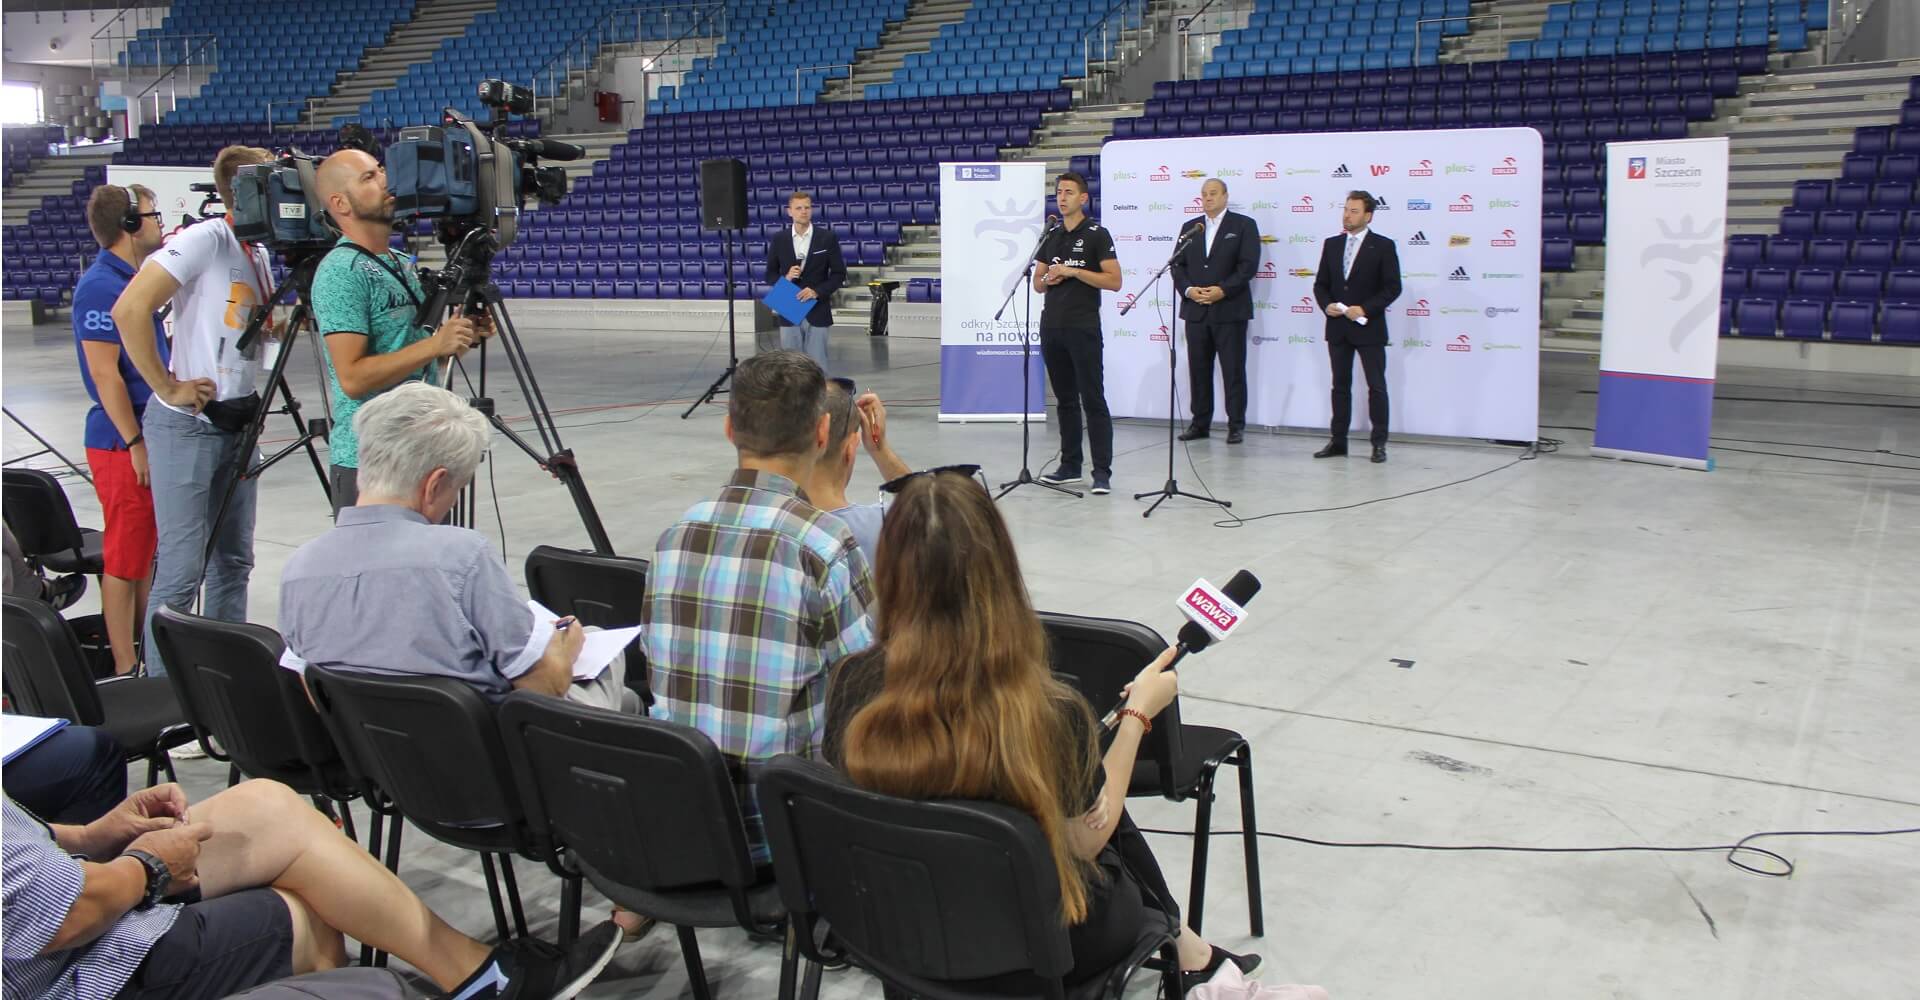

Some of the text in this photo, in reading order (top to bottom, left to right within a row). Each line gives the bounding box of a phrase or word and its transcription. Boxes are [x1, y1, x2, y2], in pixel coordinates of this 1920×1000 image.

[1655, 157, 1686, 165] Miasto
[1370, 165, 1390, 176] WP
[1655, 167, 1702, 178] Szczecin
[84, 310, 113, 331] 85
[961, 320, 1040, 330] odkryj Szczein
[976, 332, 1039, 341] na nowo
[1191, 591, 1232, 626] wawa
